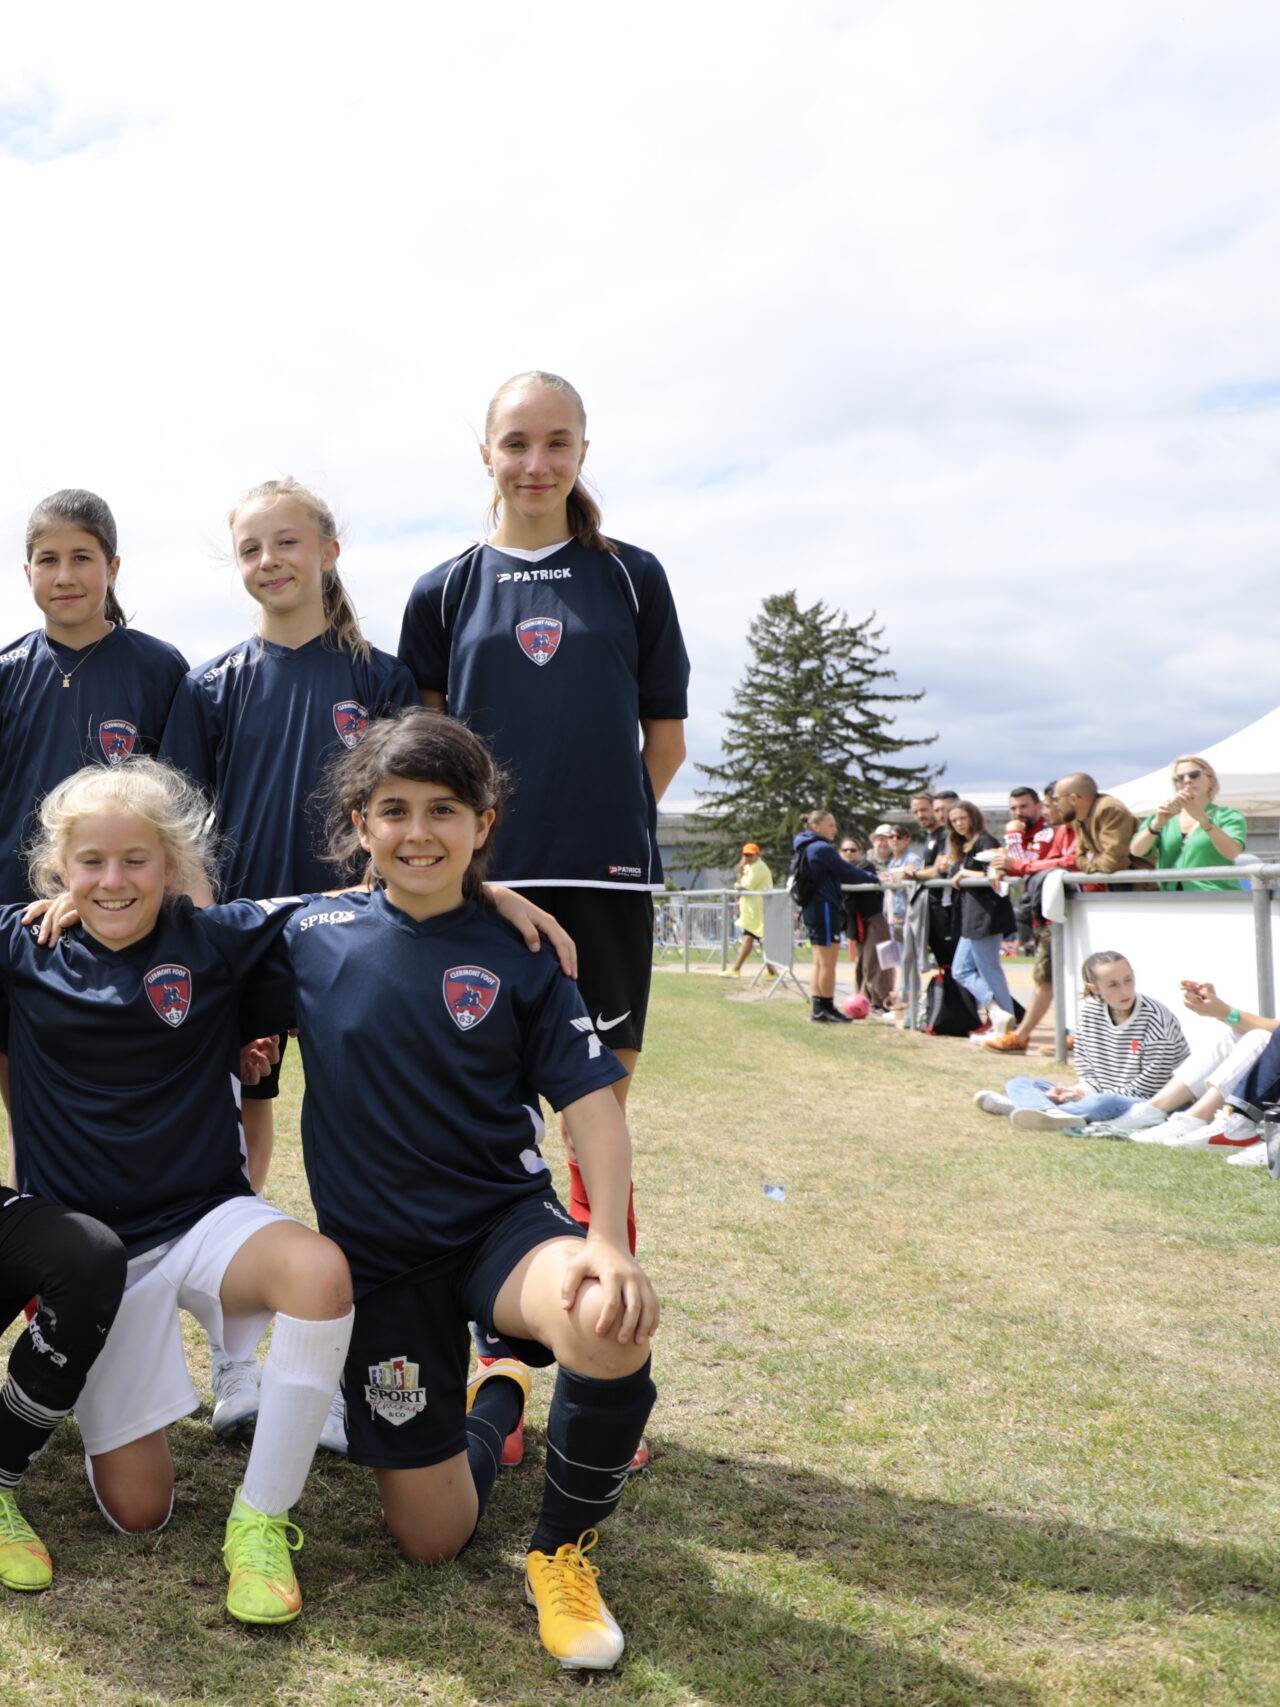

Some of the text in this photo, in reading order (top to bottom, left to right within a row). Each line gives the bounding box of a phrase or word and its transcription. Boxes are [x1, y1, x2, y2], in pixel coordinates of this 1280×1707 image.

[513, 567, 572, 583] PATRICK
[169, 1012, 180, 1021] 63
[460, 1014, 472, 1024] 63
[368, 1388, 424, 1403] SPORT
